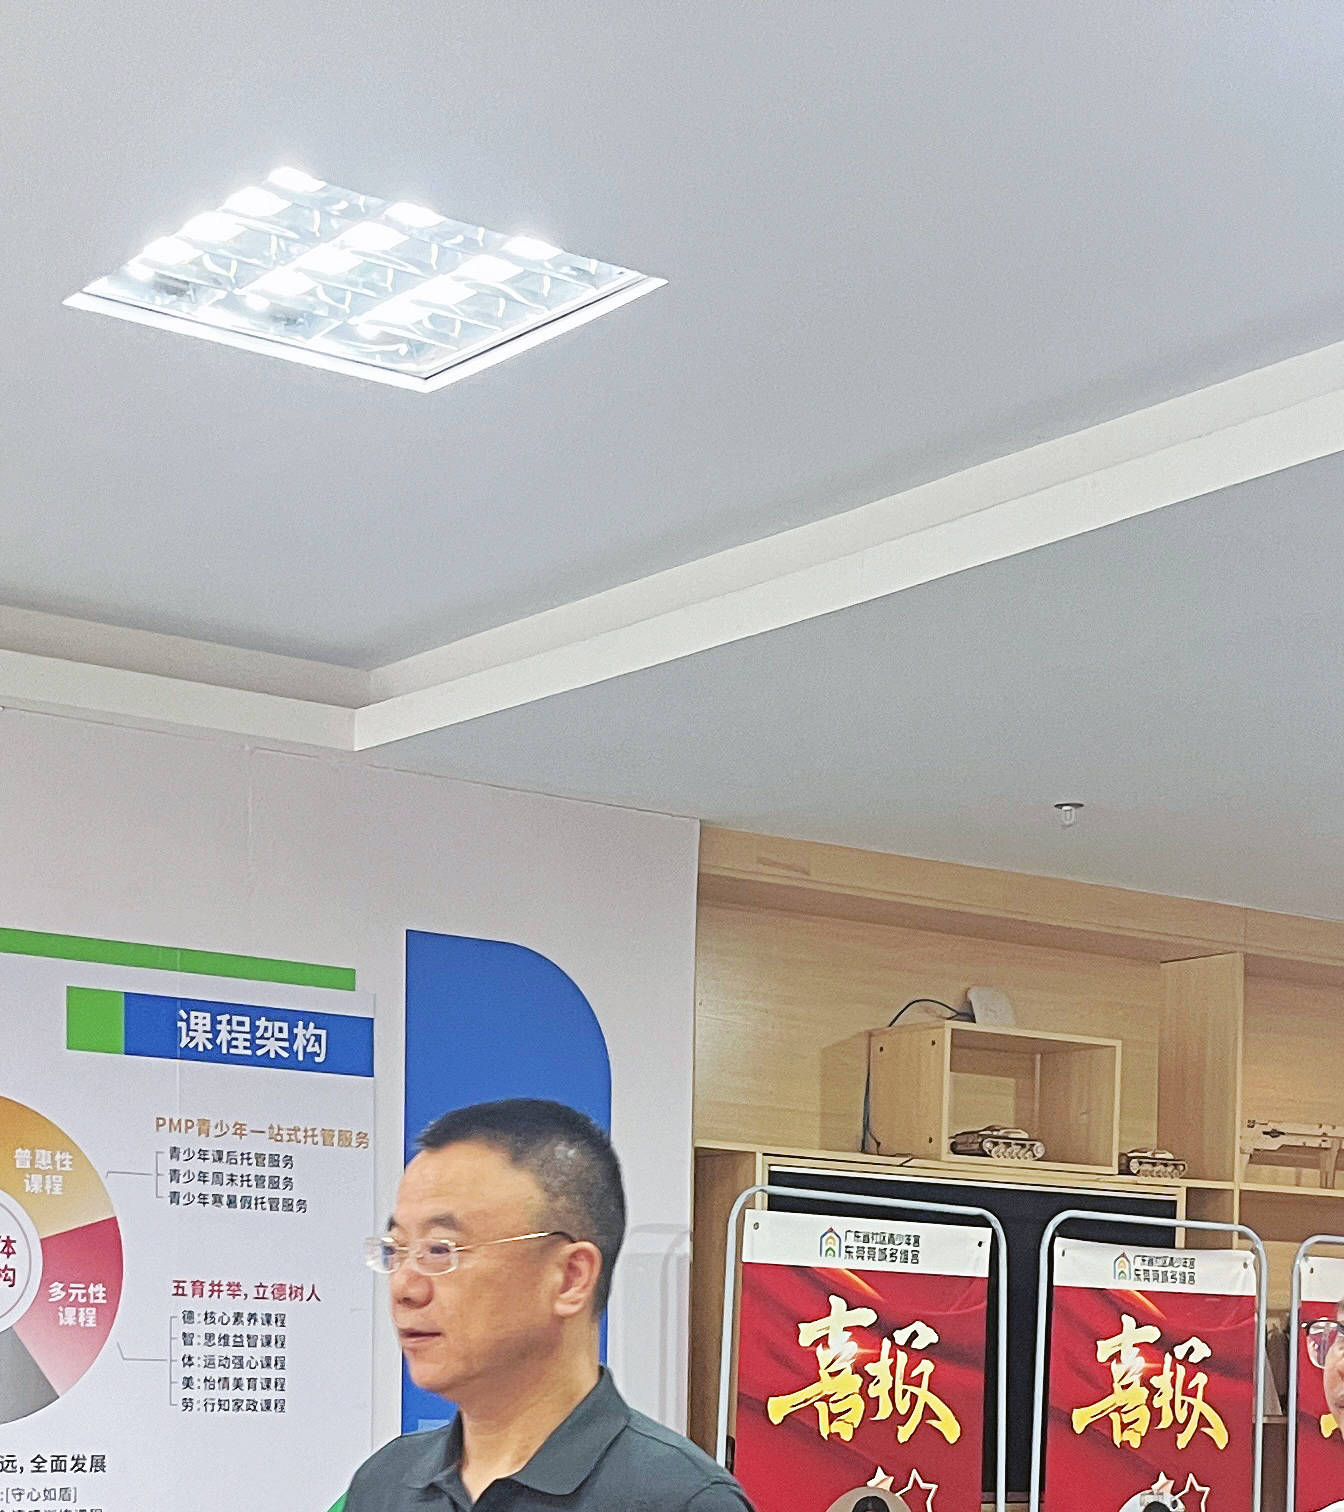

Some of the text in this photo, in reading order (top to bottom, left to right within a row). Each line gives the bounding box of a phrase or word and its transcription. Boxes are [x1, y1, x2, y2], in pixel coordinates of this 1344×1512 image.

[177, 1009, 328, 1063] 课程架构
[156, 1116, 370, 1150] PMP青少年一站式托管服务
[14, 1148, 73, 1172] 普惠性
[168, 1146, 294, 1170] 青少年课后托管服务
[23, 1174, 64, 1195] 课程
[168, 1168, 294, 1192] 青少年周末托管服务
[168, 1190, 307, 1214] 青少年寒暑假托管服务
[48, 1281, 107, 1305] 多元性
[171, 1279, 321, 1302] 五育并举，立德树人
[57, 1306, 97, 1328] 课程
[767, 1294, 961, 1445] 喜报
[1071, 1313, 1229, 1450] 喜报
